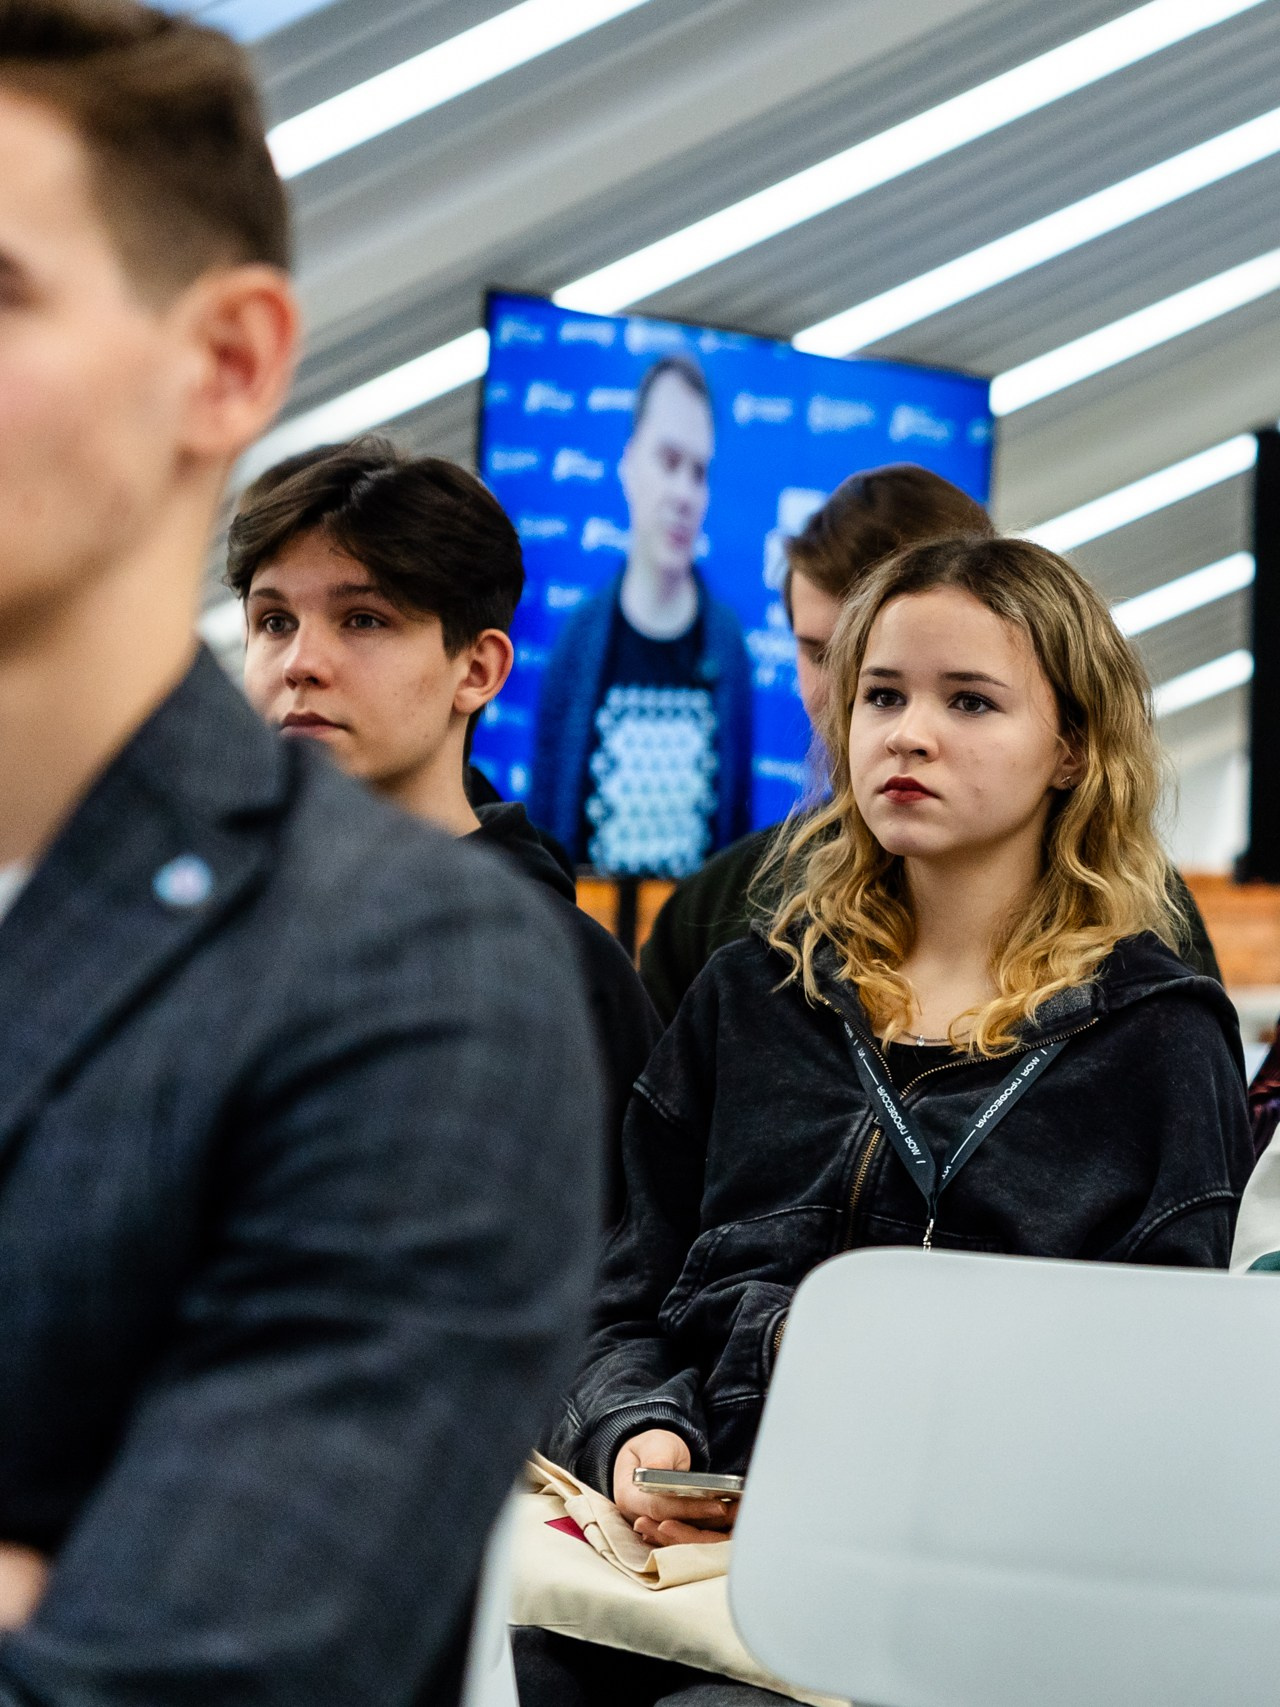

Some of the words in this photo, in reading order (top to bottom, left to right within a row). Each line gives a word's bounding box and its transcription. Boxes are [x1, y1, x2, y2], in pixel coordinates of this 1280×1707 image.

[1020, 1056, 1040, 1077] МОЯ
[876, 1085, 909, 1136] ПРОФЕССИЯ
[975, 1077, 1022, 1129] ПРОФЕССИЯ
[904, 1135, 922, 1156] МОЯ
